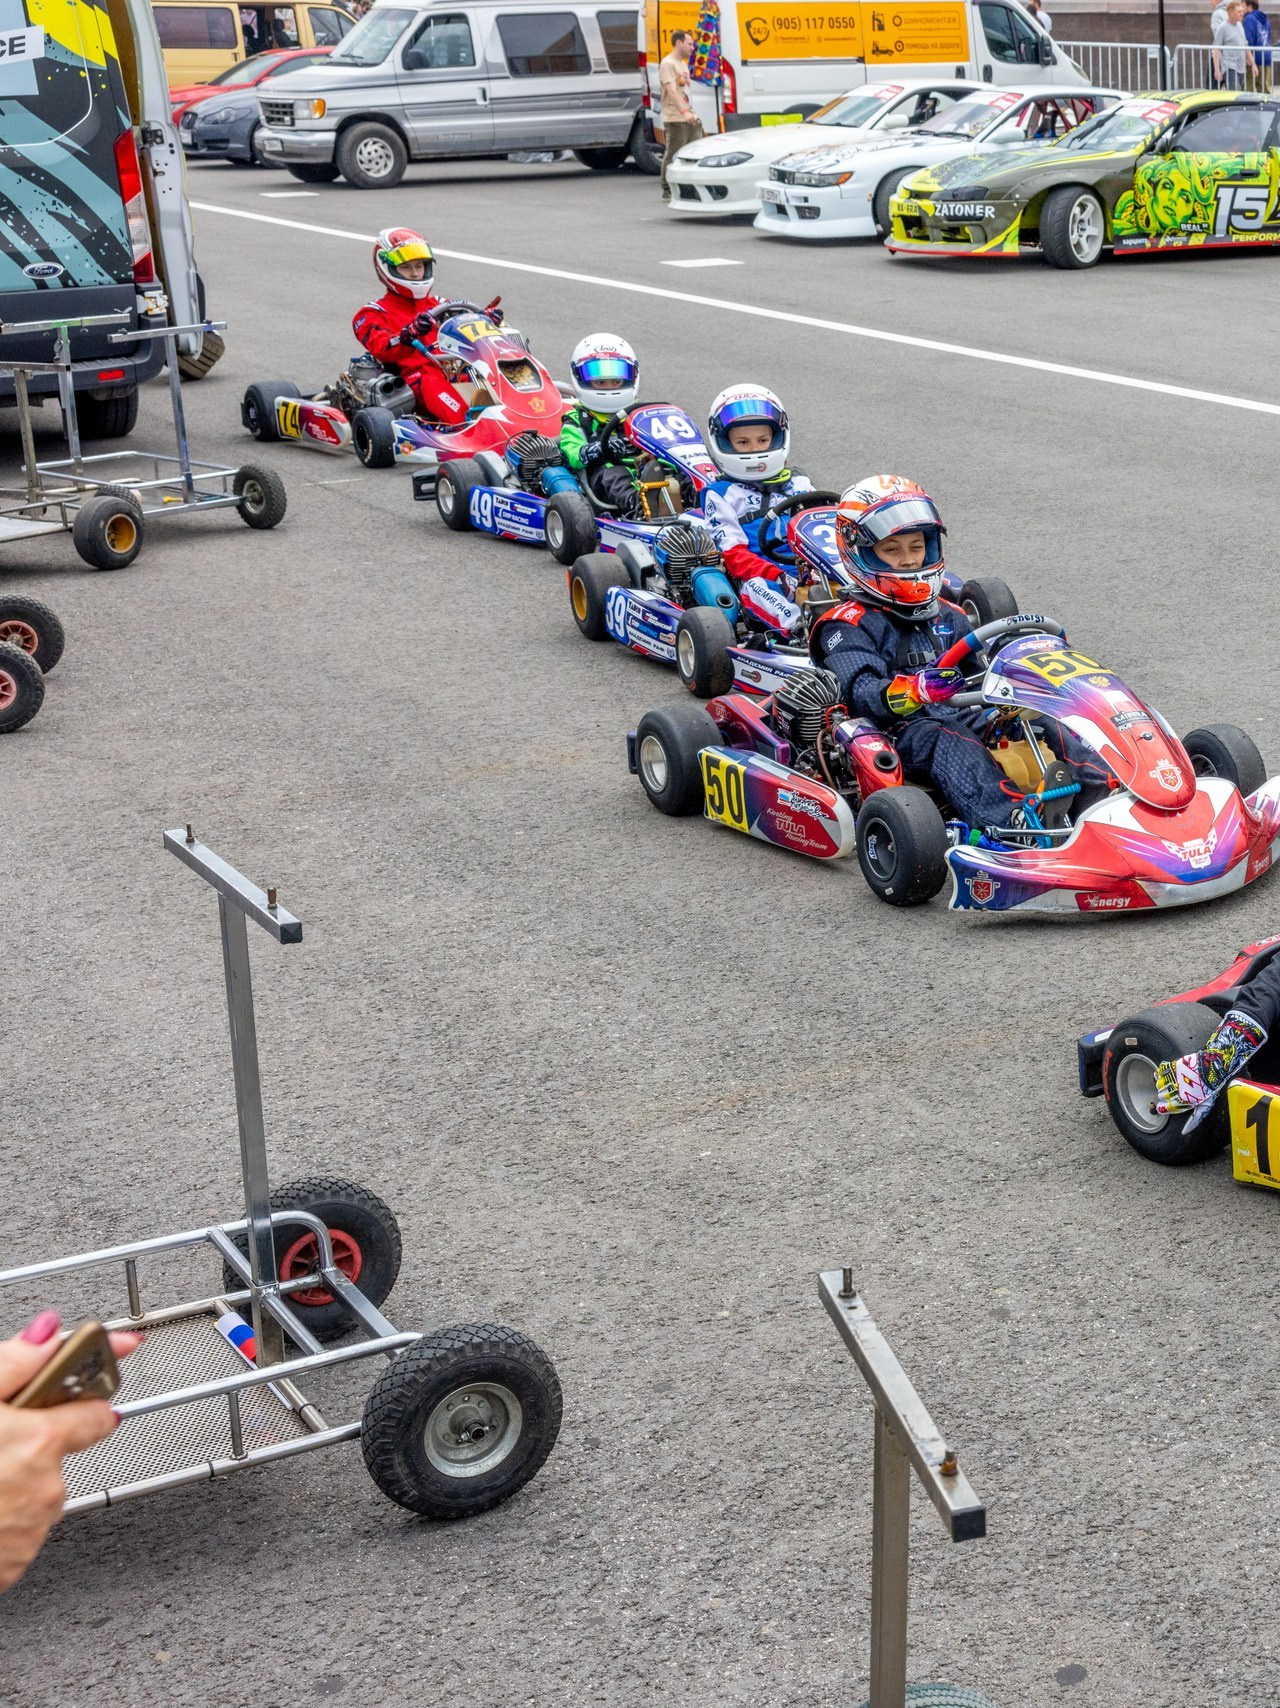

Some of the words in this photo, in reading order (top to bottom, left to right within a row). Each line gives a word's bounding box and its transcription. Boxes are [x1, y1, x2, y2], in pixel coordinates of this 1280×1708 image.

[772, 15, 801, 32] (905)
[805, 16, 825, 30] 117
[828, 16, 855, 30] 0550
[934, 203, 996, 219] ZATONER
[1180, 223, 1203, 232] REAL
[32, 265, 54, 275] Ford
[281, 400, 300, 436] 74
[650, 415, 696, 441] 49
[470, 488, 493, 528] 49
[746, 579, 777, 607] КАДЕМИЯ
[605, 587, 626, 637] 39
[827, 632, 842, 649] OMP
[736, 656, 773, 673] АКАДЕМИЯ
[705, 754, 744, 825] 50
[766, 807, 793, 822] Karting
[775, 817, 806, 838] TULA
[1181, 844, 1212, 860] TULA
